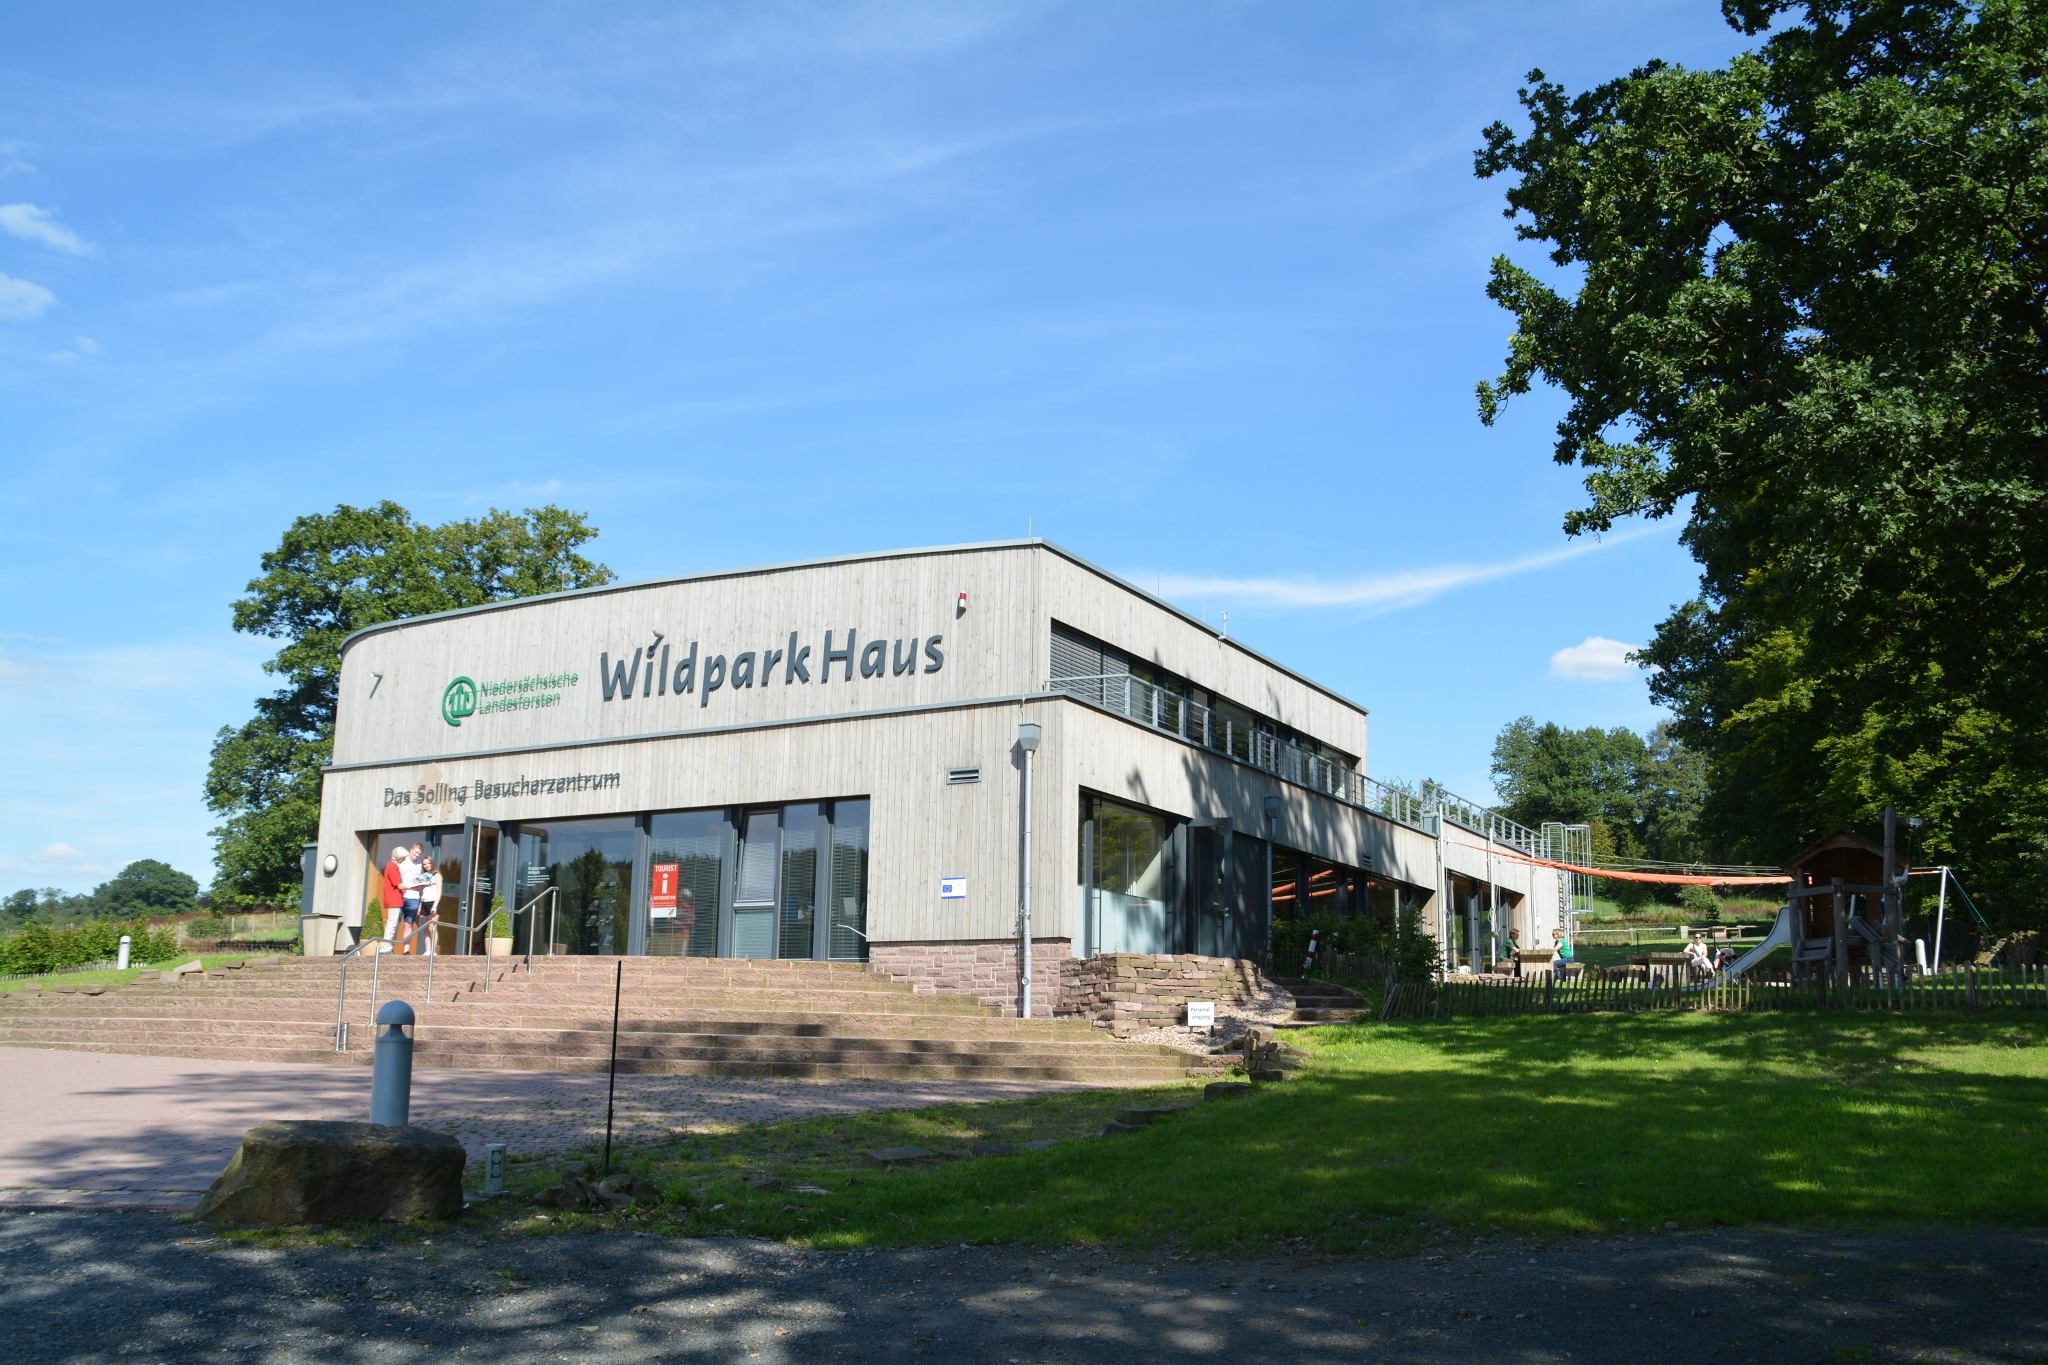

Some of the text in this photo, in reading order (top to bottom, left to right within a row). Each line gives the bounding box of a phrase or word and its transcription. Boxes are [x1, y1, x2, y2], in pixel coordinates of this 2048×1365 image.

[480, 670, 579, 696] Niedersächsische
[479, 692, 561, 713] Landesforsten
[384, 772, 620, 807] Das Solling Besucherzentrum
[655, 864, 678, 873] TOURIST
